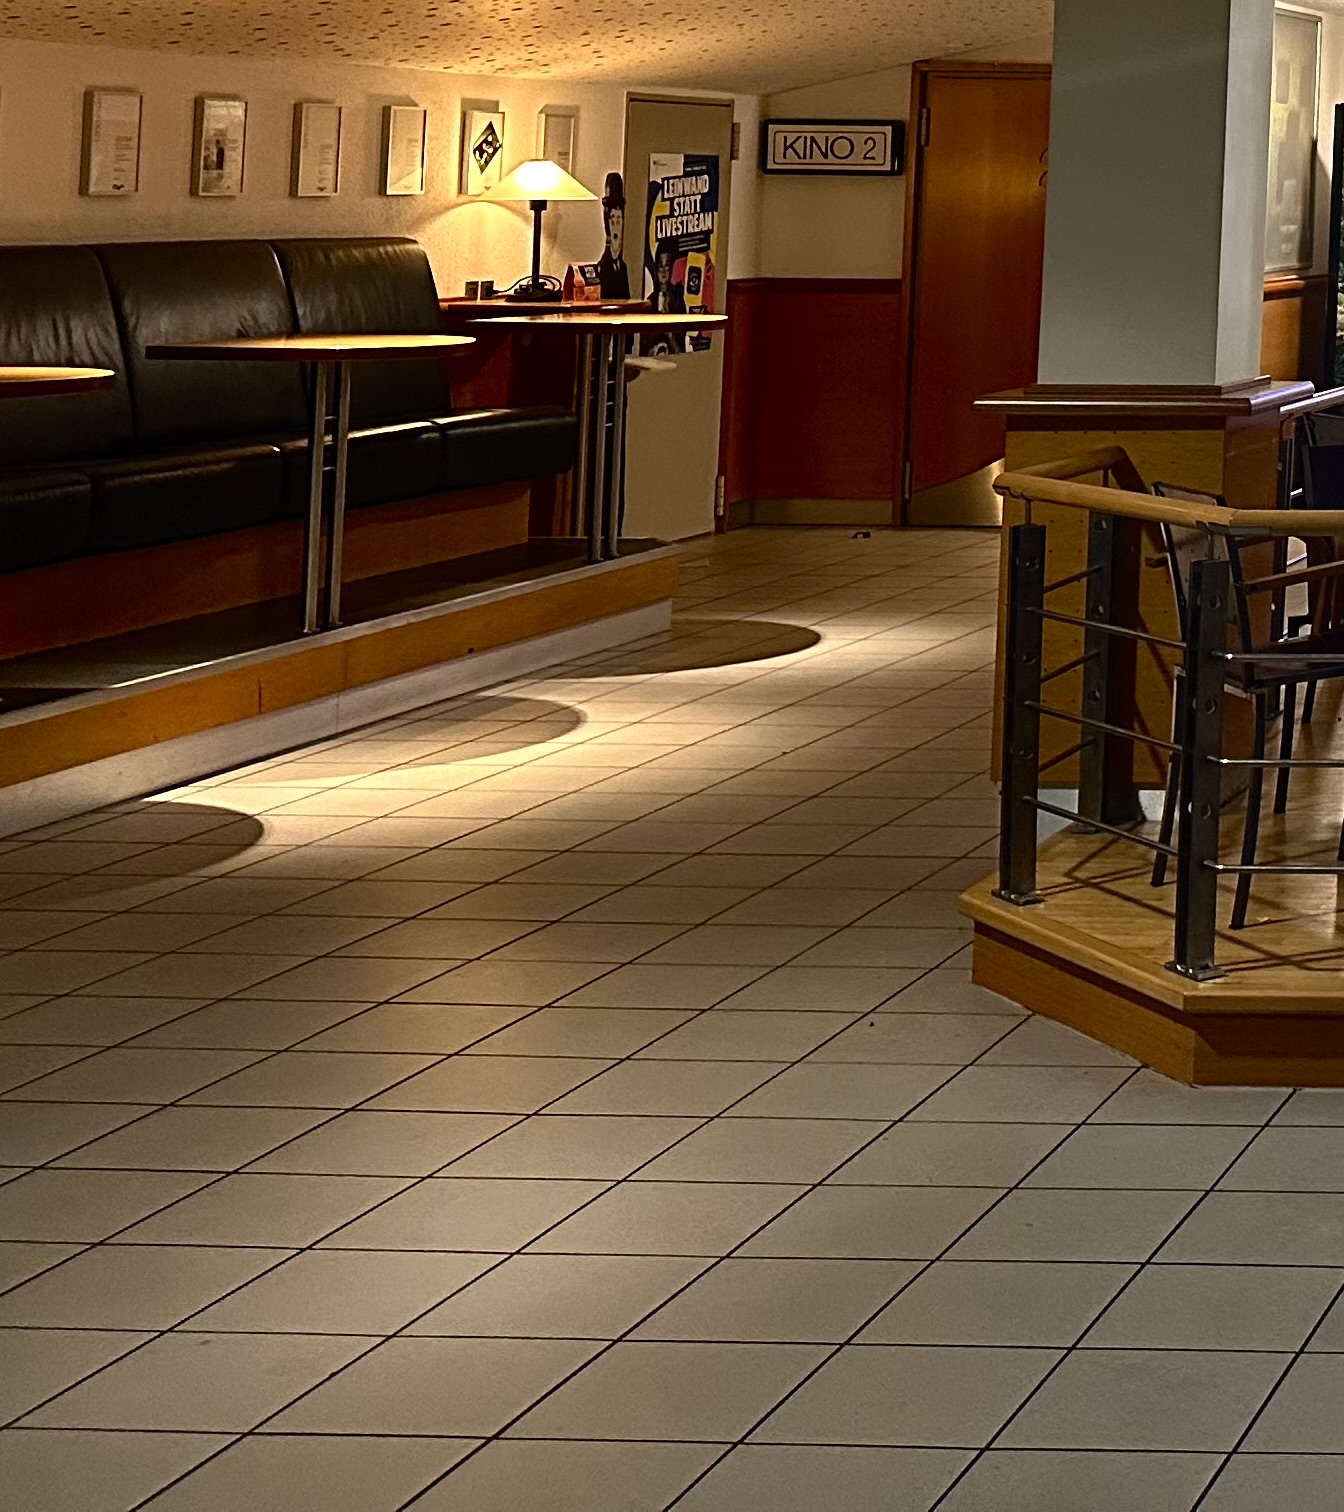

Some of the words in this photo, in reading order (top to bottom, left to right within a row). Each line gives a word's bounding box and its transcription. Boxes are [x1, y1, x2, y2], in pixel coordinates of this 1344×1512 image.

[782, 135, 855, 160] KINO
[862, 136, 877, 160] 2
[663, 174, 710, 199] LEINWAND
[673, 194, 702, 217] STATT
[657, 211, 713, 239] LIVESTREAM
